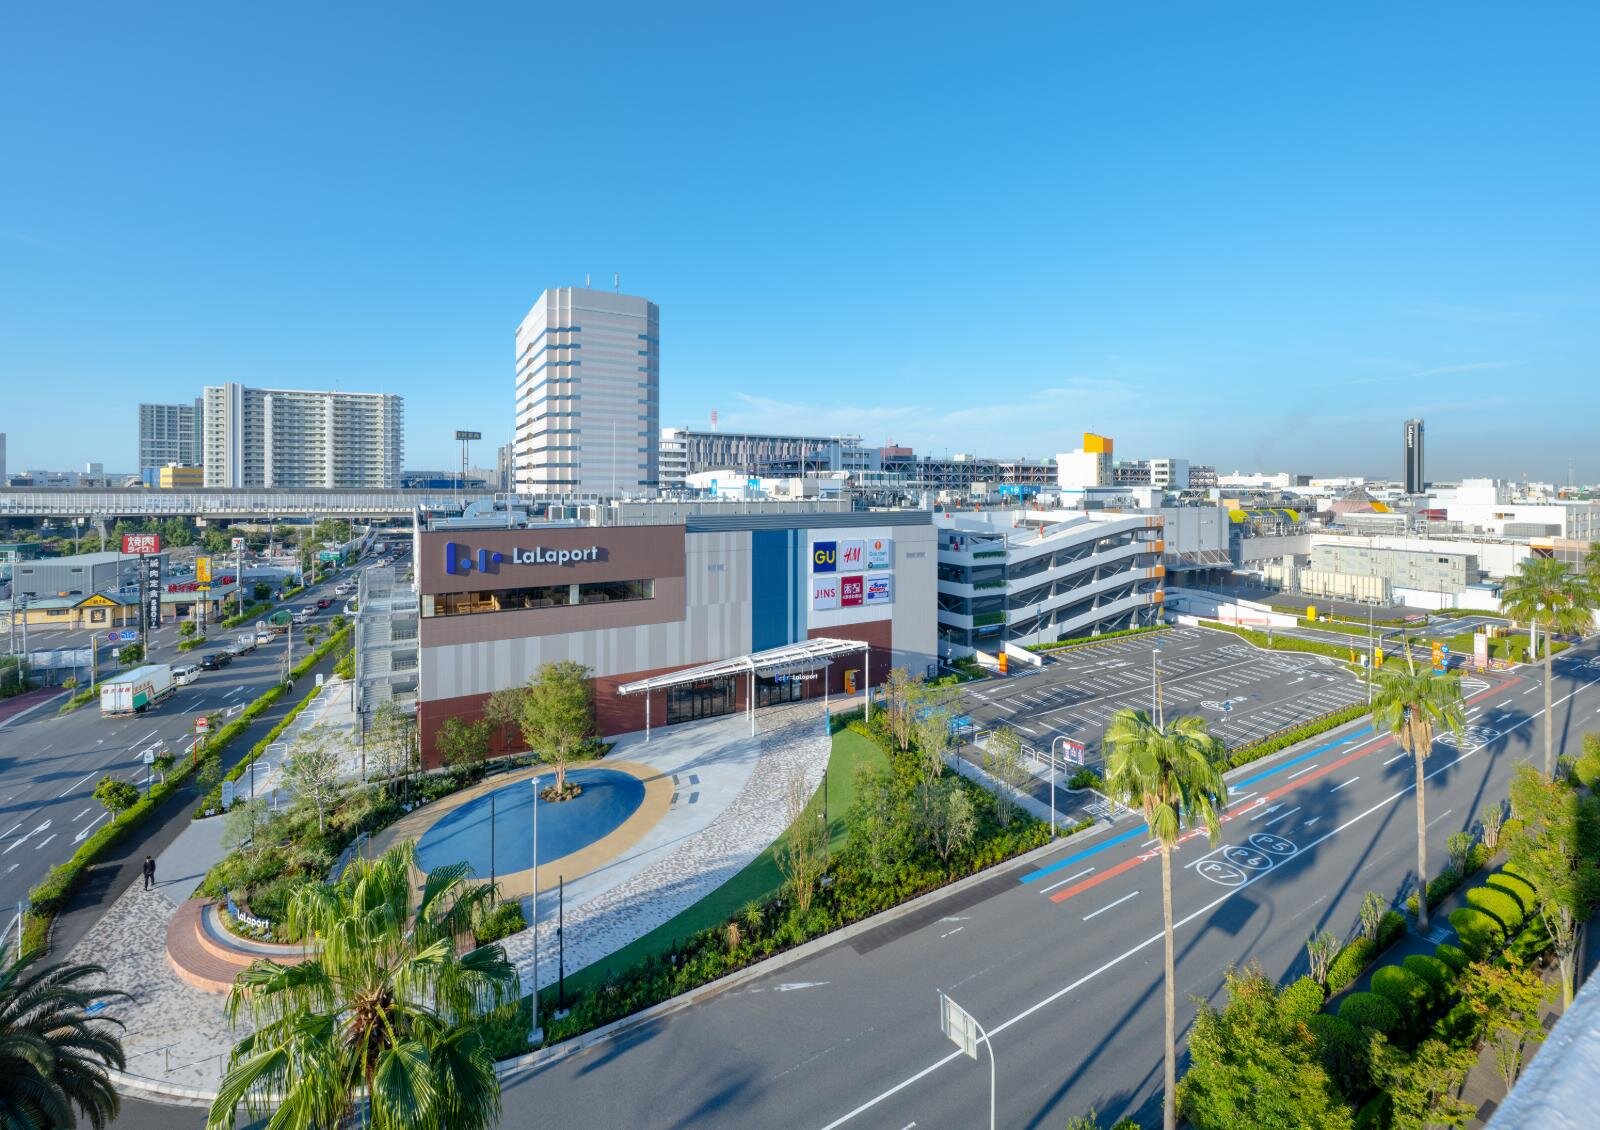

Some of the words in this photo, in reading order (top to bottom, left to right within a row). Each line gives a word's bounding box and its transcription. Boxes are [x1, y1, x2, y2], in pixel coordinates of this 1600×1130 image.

[127, 536, 155, 547] 焼肉
[513, 545, 598, 566] LaLaport
[815, 550, 835, 565] GU
[843, 547, 861, 563] H&M
[237, 909, 269, 929] LaLaport
